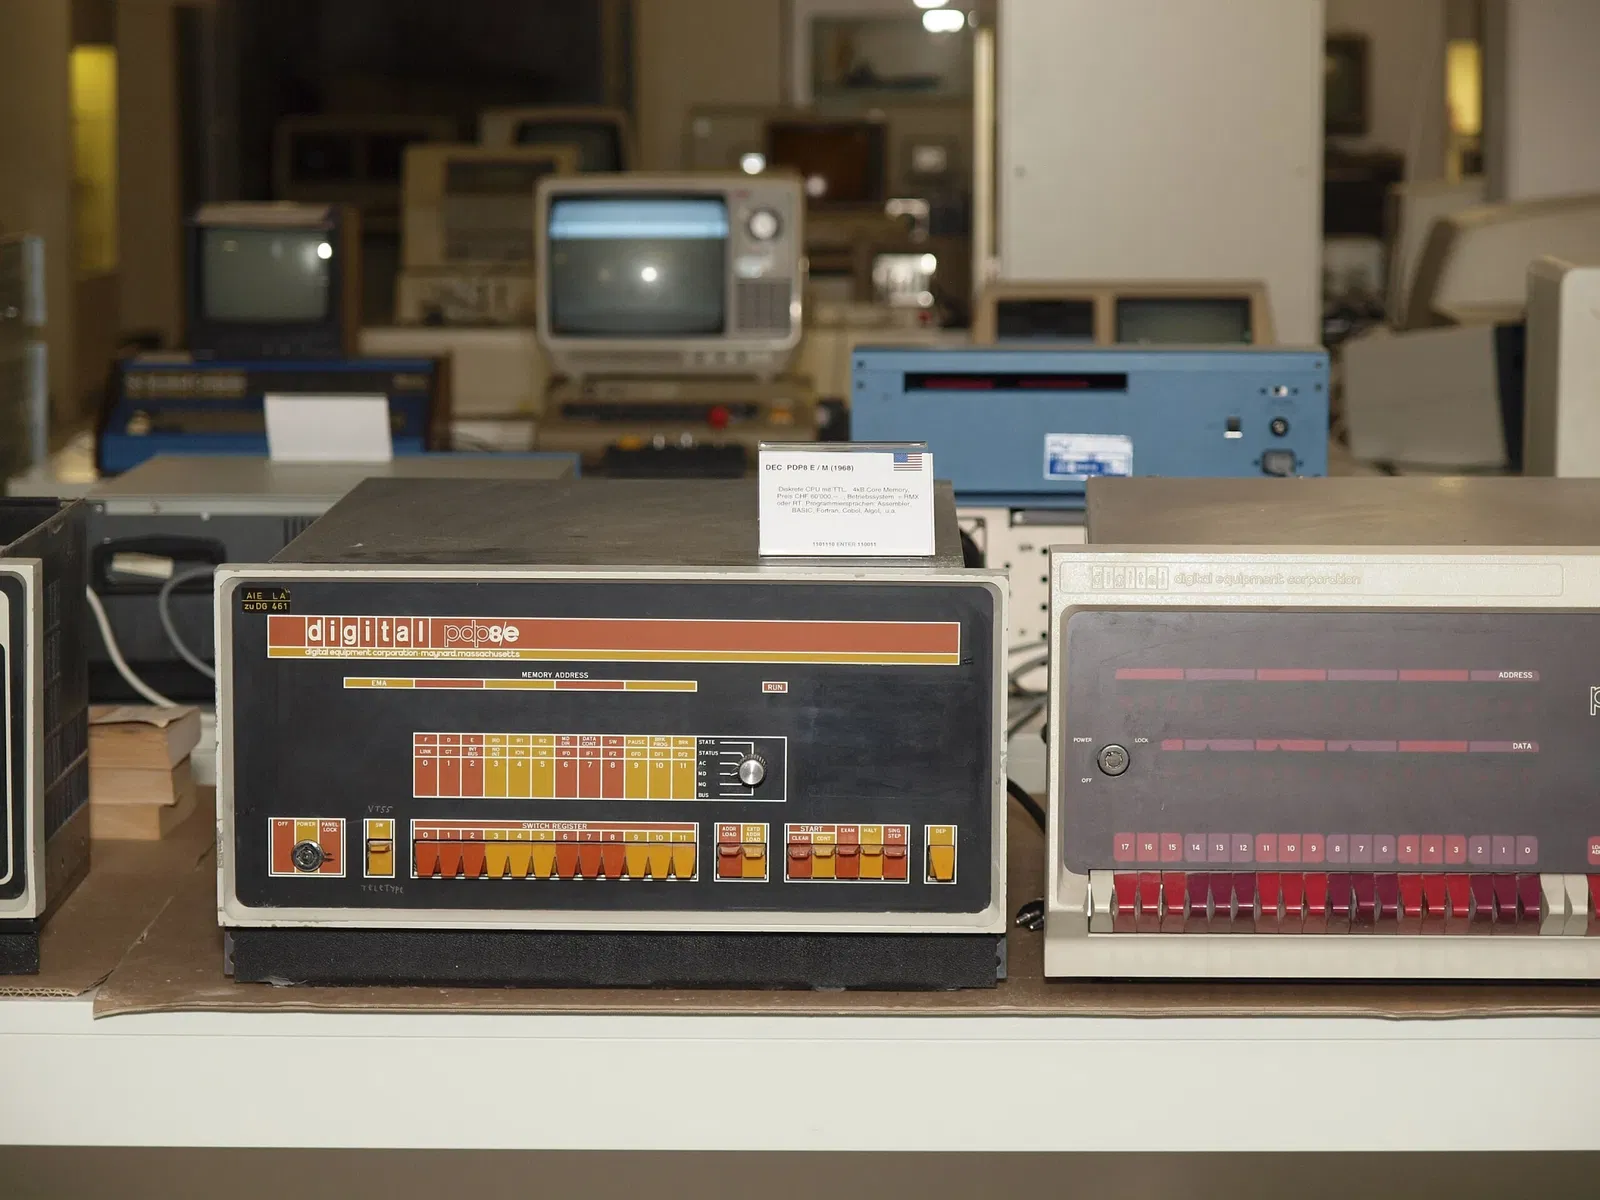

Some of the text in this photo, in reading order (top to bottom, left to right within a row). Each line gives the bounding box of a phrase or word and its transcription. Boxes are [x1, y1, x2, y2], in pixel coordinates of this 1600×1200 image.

[830, 464, 854, 472] (1968)
[1091, 566, 1361, 590] digital digital equipment corporation
[246, 592, 262, 600] AIE
[308, 620, 424, 645] digital
[330, 649, 372, 658] equipment
[372, 650, 418, 658] corporation
[458, 650, 520, 658] massachusetts
[1498, 671, 1533, 679] ADDRESS
[1512, 742, 1532, 750] DATA
[368, 805, 394, 814] VT55
[522, 822, 550, 830] SWITCH
[655, 834, 664, 842] 10
[1240, 844, 1248, 852] 12
[1478, 846, 1483, 854] 2
